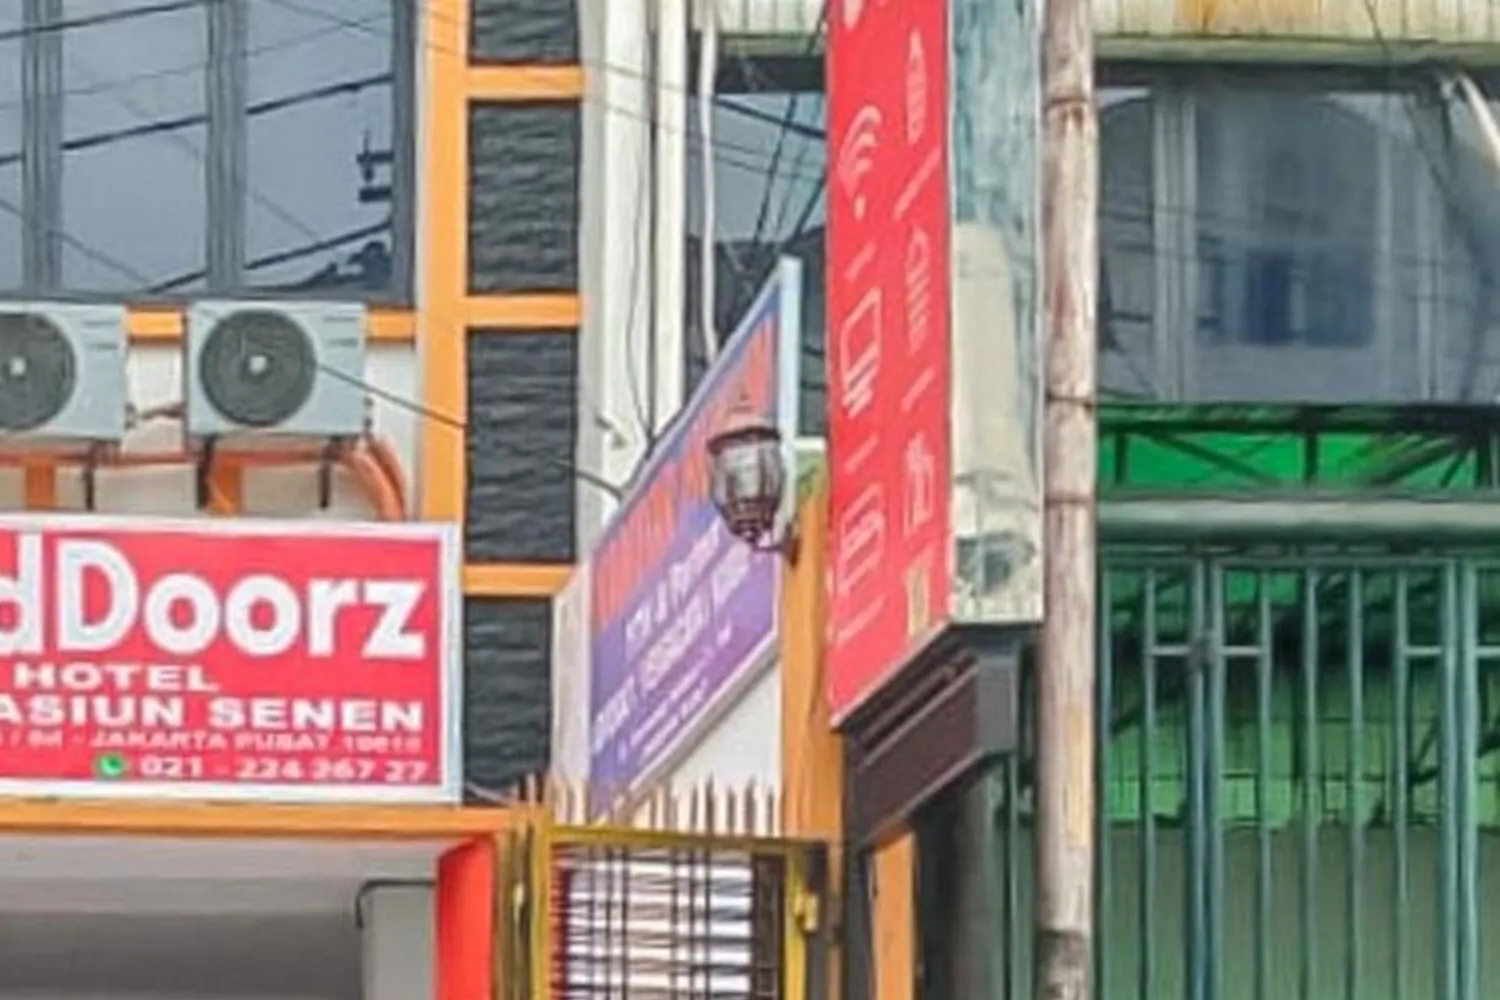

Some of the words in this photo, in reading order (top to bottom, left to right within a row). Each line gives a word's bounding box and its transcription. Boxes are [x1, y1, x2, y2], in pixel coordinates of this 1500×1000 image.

[13, 661, 220, 692] HOTEL
[207, 698, 424, 731] SENEN
[89, 731, 228, 751] JAKARTA
[138, 755, 203, 778] 021
[237, 757, 304, 780] 224
[384, 760, 428, 782] 27
